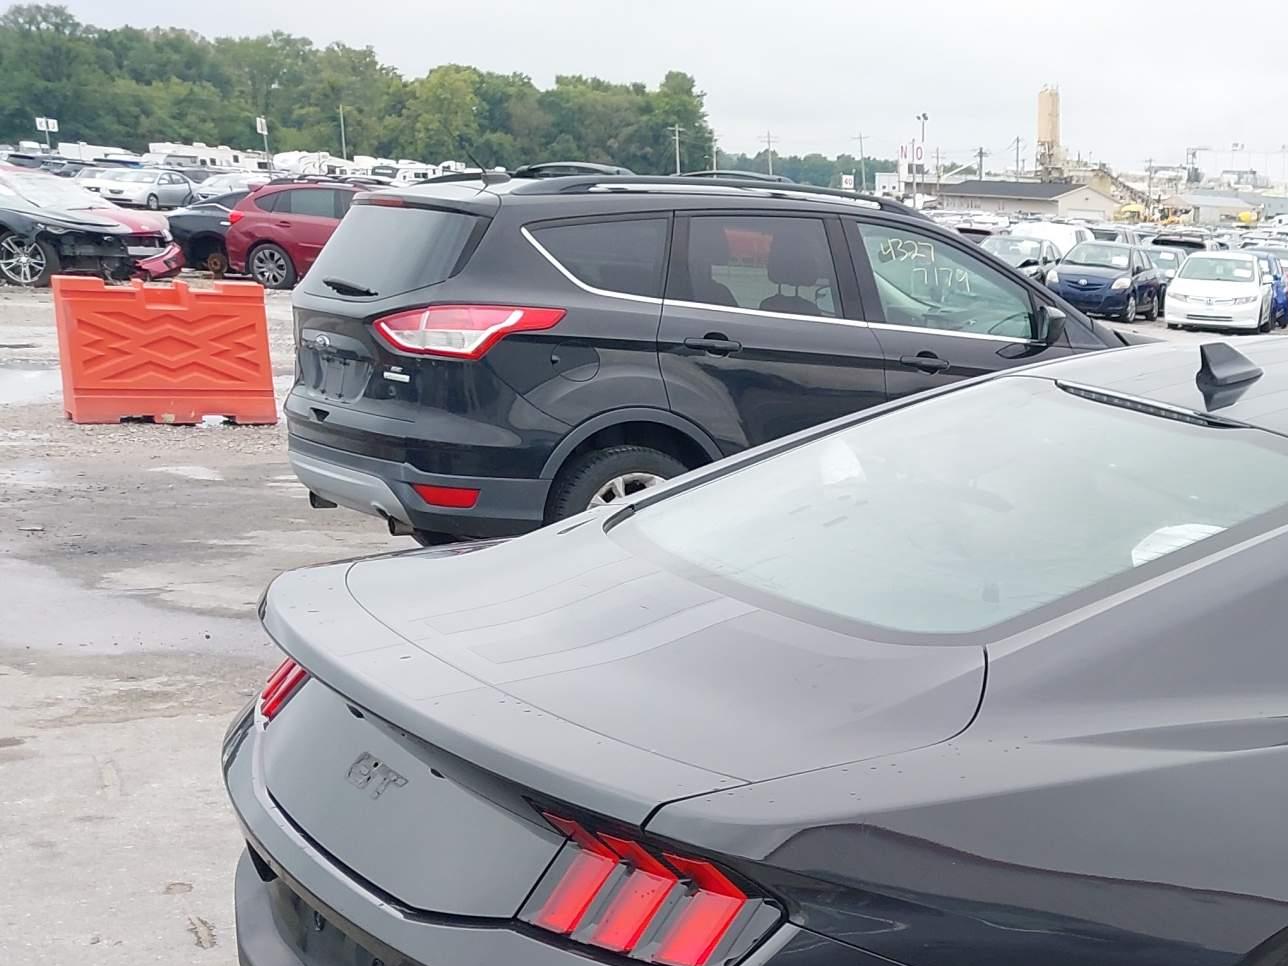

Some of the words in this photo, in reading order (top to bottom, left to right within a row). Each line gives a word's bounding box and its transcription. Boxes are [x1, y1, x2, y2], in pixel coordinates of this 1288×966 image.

[900, 145, 908, 159] N
[880, 238, 935, 262] 4327
[912, 267, 971, 293] 7179
[345, 751, 408, 800] GT
